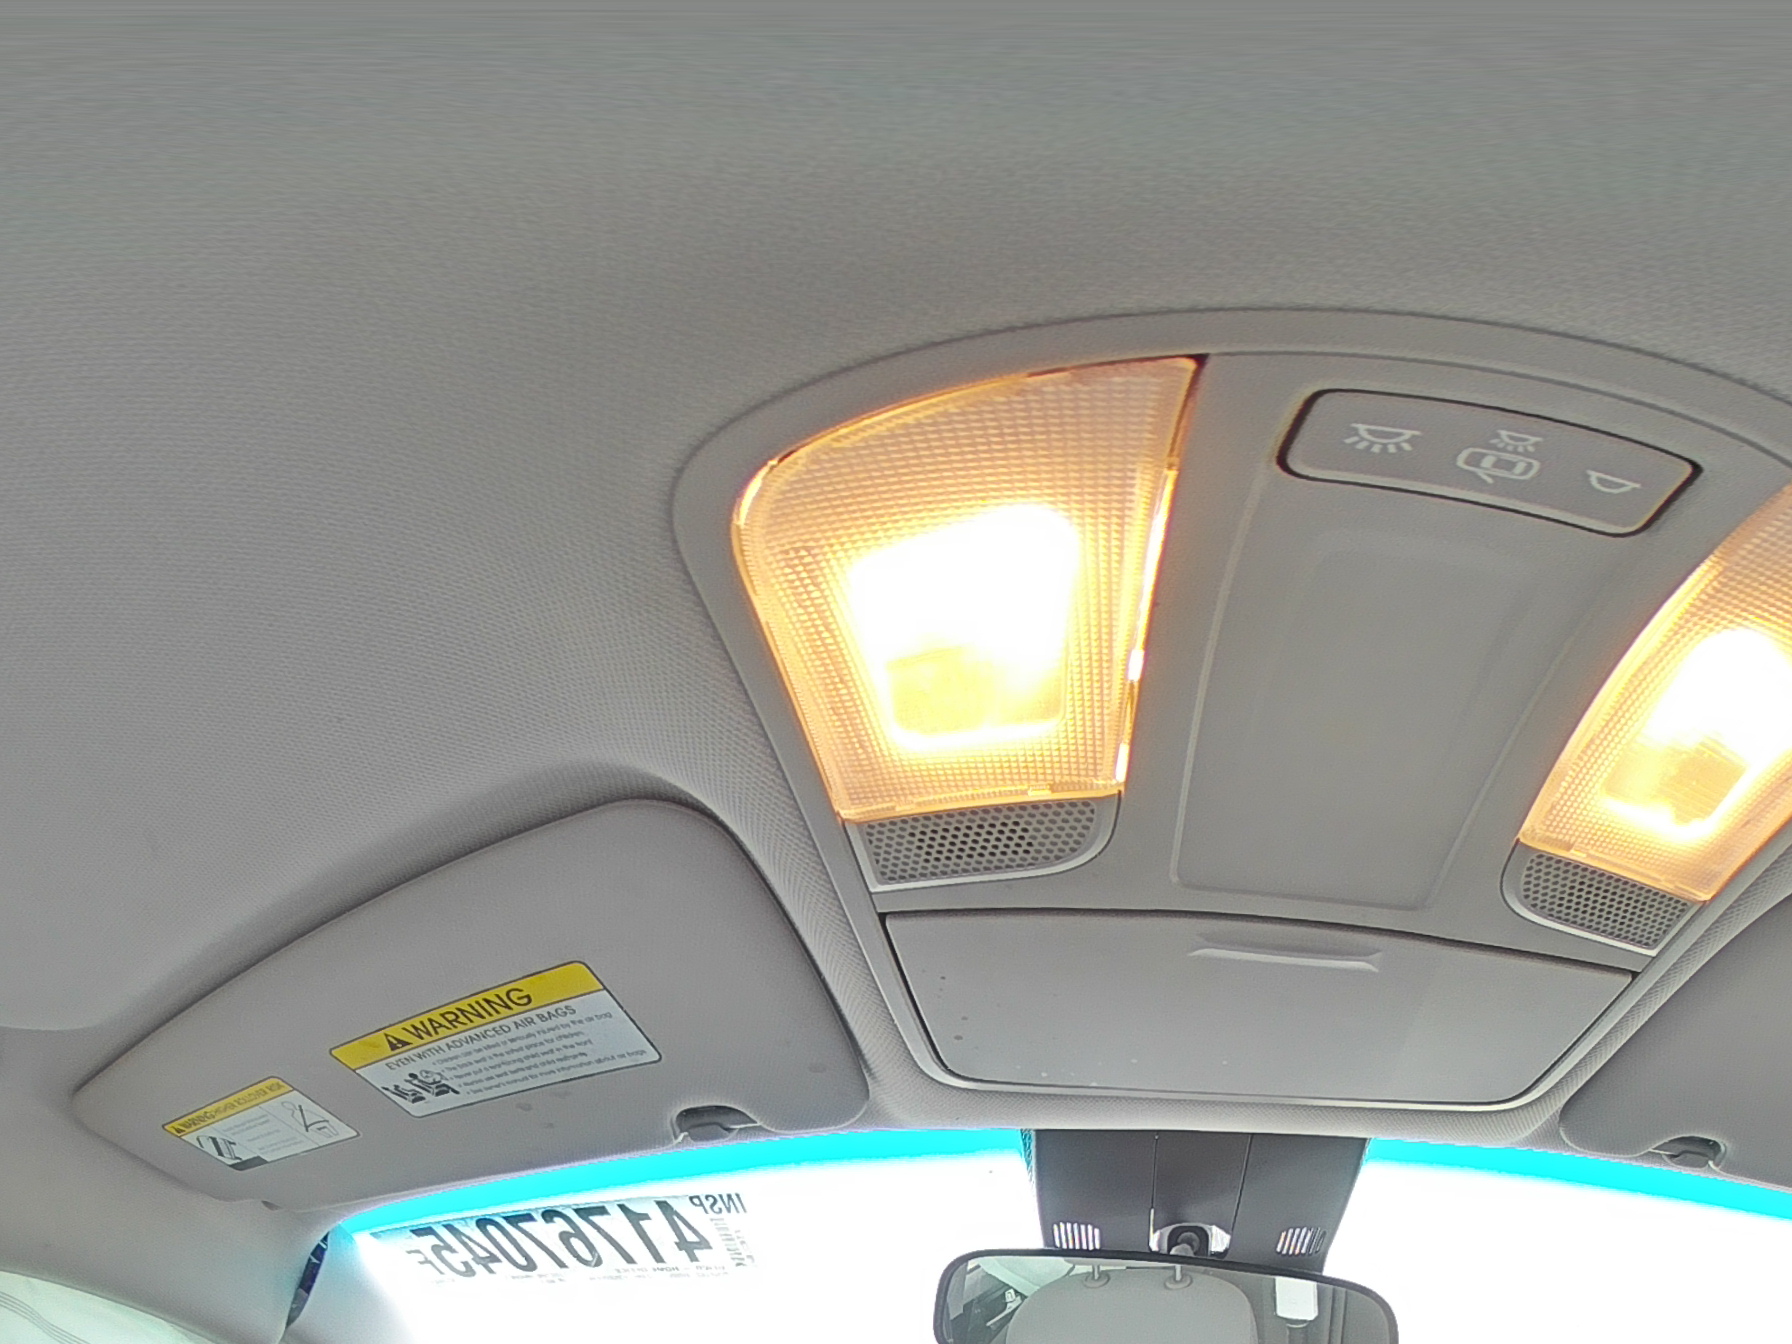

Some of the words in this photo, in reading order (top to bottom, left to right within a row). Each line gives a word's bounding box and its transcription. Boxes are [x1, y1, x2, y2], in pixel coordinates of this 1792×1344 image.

[385, 1054, 413, 1071] EVEN
[414, 1045, 447, 1062] WITH
[446, 1023, 512, 1051] ADVANCED
[513, 1016, 538, 1032] AIR
[537, 1004, 577, 1023] BAGS
[402, 988, 533, 1041] WARNING
